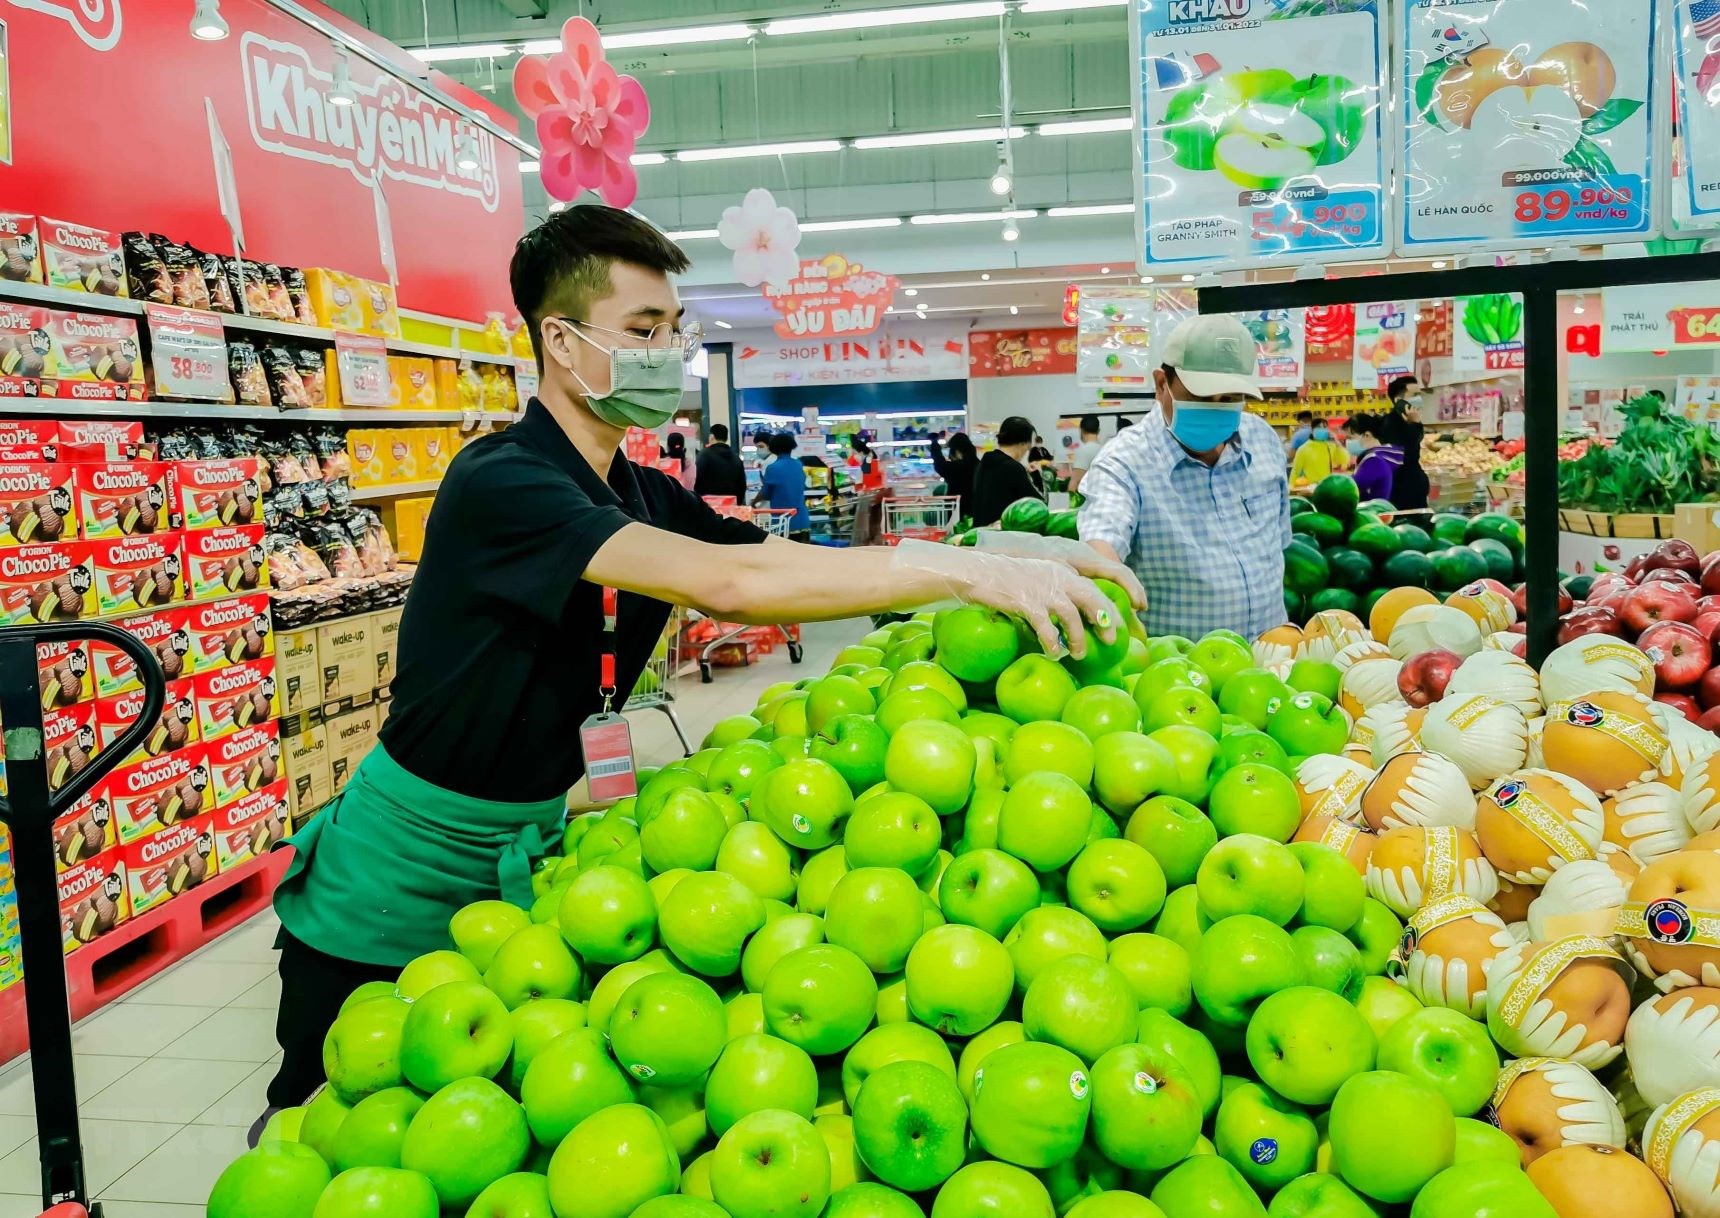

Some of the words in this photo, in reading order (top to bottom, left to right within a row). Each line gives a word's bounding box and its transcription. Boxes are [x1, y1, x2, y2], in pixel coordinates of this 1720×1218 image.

[1209, 20, 1262, 32] 31.01.2022
[1434, 205, 1458, 215] HÀN
[1461, 203, 1494, 214] QUỐC
[1575, 207, 1628, 219] vnd/kg
[1158, 232, 1202, 242] GRANNY
[1205, 229, 1237, 239] SMITH
[780, 348, 819, 360] SHOP
[93, 471, 149, 489] ChocoPie
[194, 467, 245, 484] ChocoPie
[201, 533, 251, 553] ChocoPie
[109, 543, 165, 564] ChocoPie
[2, 553, 71, 577] ChocoPie
[201, 605, 255, 627] ChocoPie
[332, 630, 364, 647] wake-up
[285, 643, 314, 659] wake-up
[209, 669, 261, 694] ChocoPie
[340, 719, 371, 740] wake-up
[222, 731, 269, 760] ChocoPie
[293, 739, 325, 759] wake-up
[127, 759, 190, 791] ChocoPie
[227, 794, 276, 825] ChocoPie
[142, 827, 197, 862] ChocoPie
